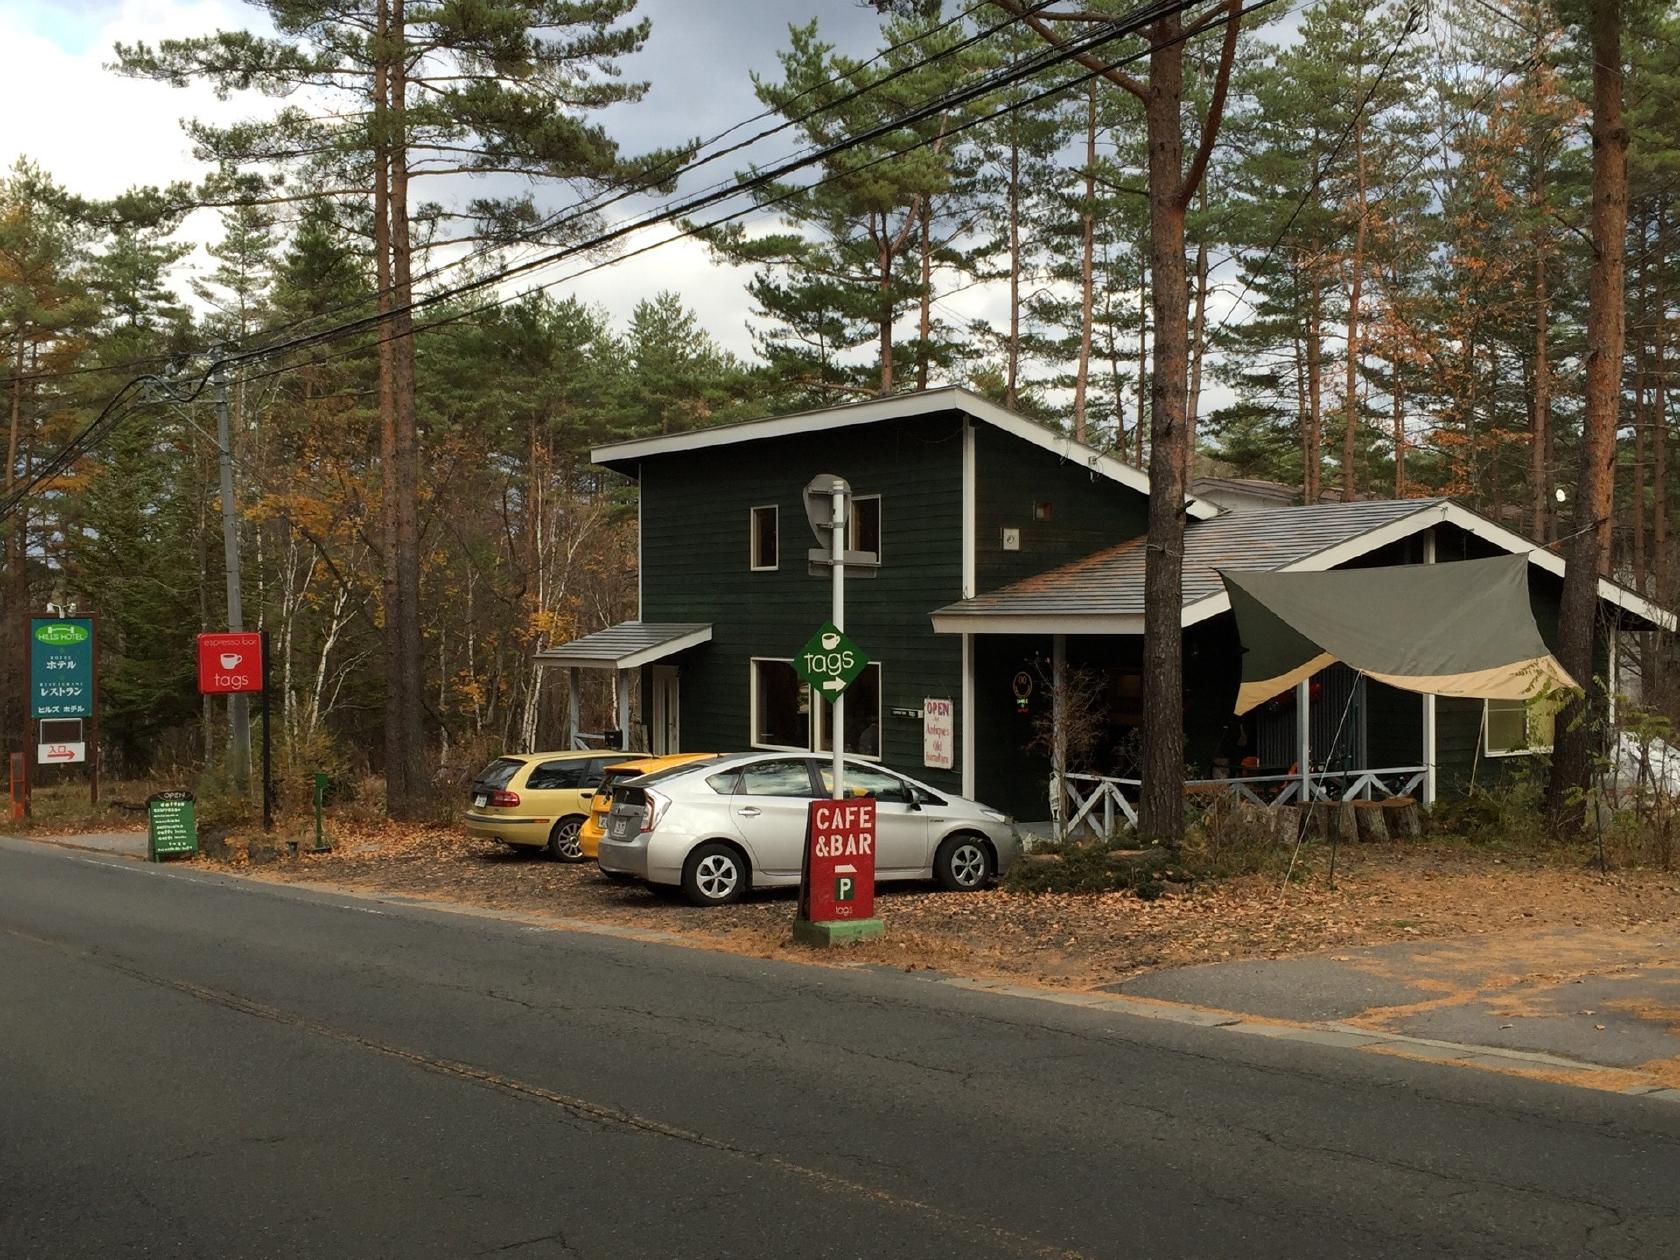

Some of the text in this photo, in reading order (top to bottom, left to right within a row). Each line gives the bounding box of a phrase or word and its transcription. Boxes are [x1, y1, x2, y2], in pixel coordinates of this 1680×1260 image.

[60, 632, 85, 641] HOTEL
[46, 660, 77, 670] ホテル
[803, 650, 855, 676] tags
[214, 672, 249, 690] tags
[40, 687, 83, 697] レストラン
[62, 704, 86, 713] ホテル
[926, 701, 950, 717] OPEN
[49, 745, 67, 754] 入口
[163, 792, 186, 800] OPEN
[816, 806, 872, 830] CAFE
[815, 833, 872, 857] &BAR
[840, 878, 851, 900] P
